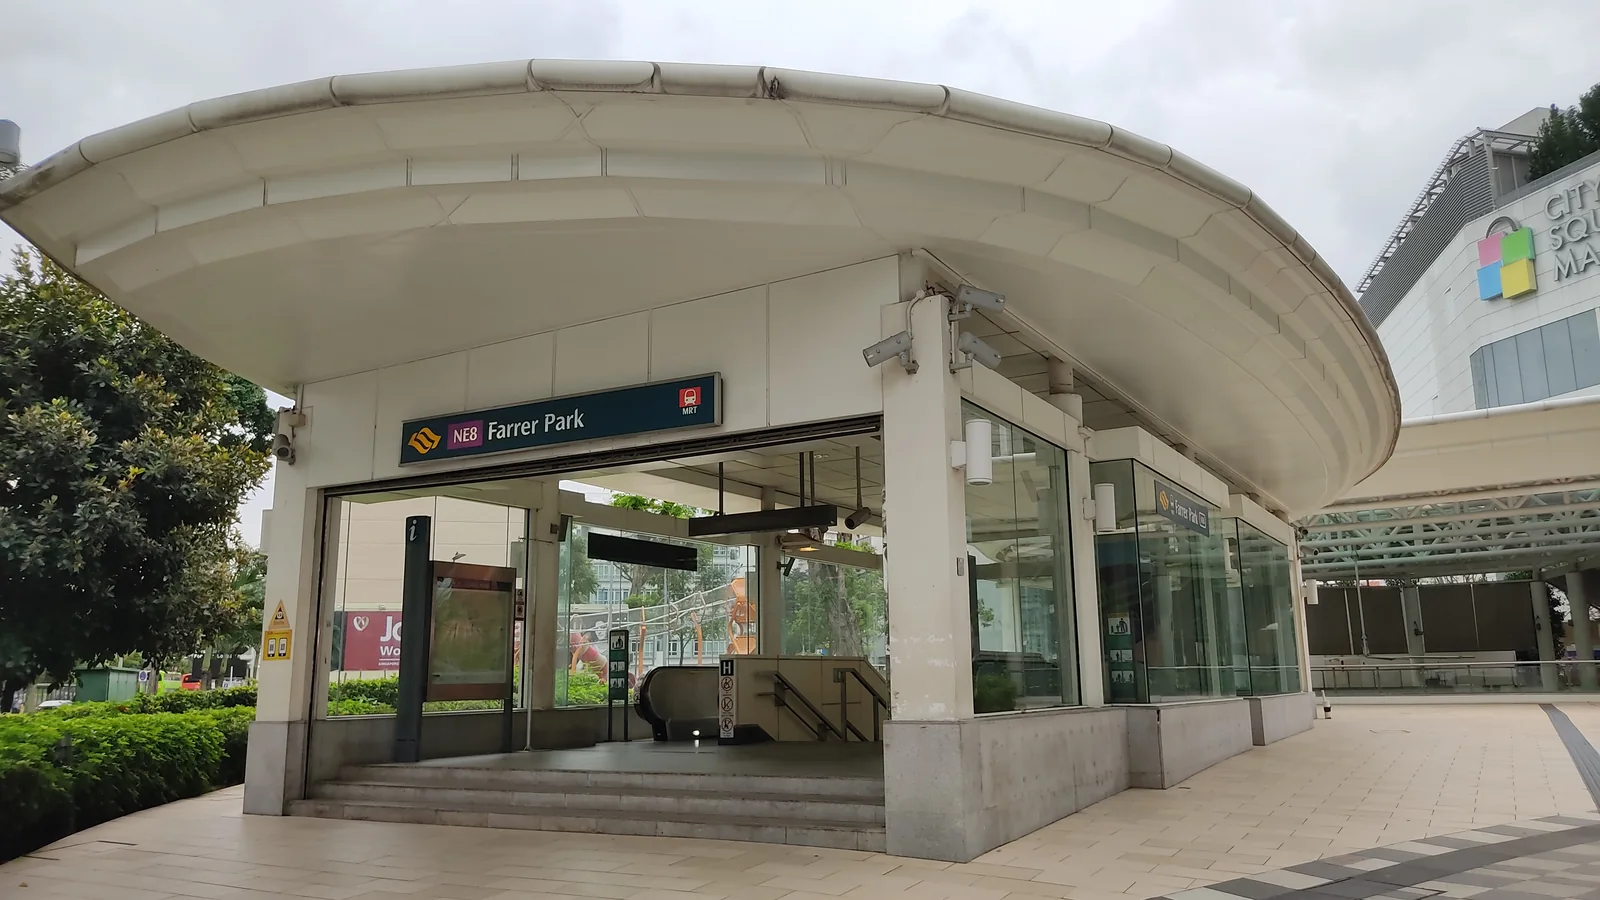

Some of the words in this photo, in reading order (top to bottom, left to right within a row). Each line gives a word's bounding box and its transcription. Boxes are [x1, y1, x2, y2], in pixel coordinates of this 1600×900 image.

[682, 406, 698, 415] MRT
[453, 426, 478, 444] NE8
[488, 419, 539, 441] Farrer
[544, 408, 585, 433] Park
